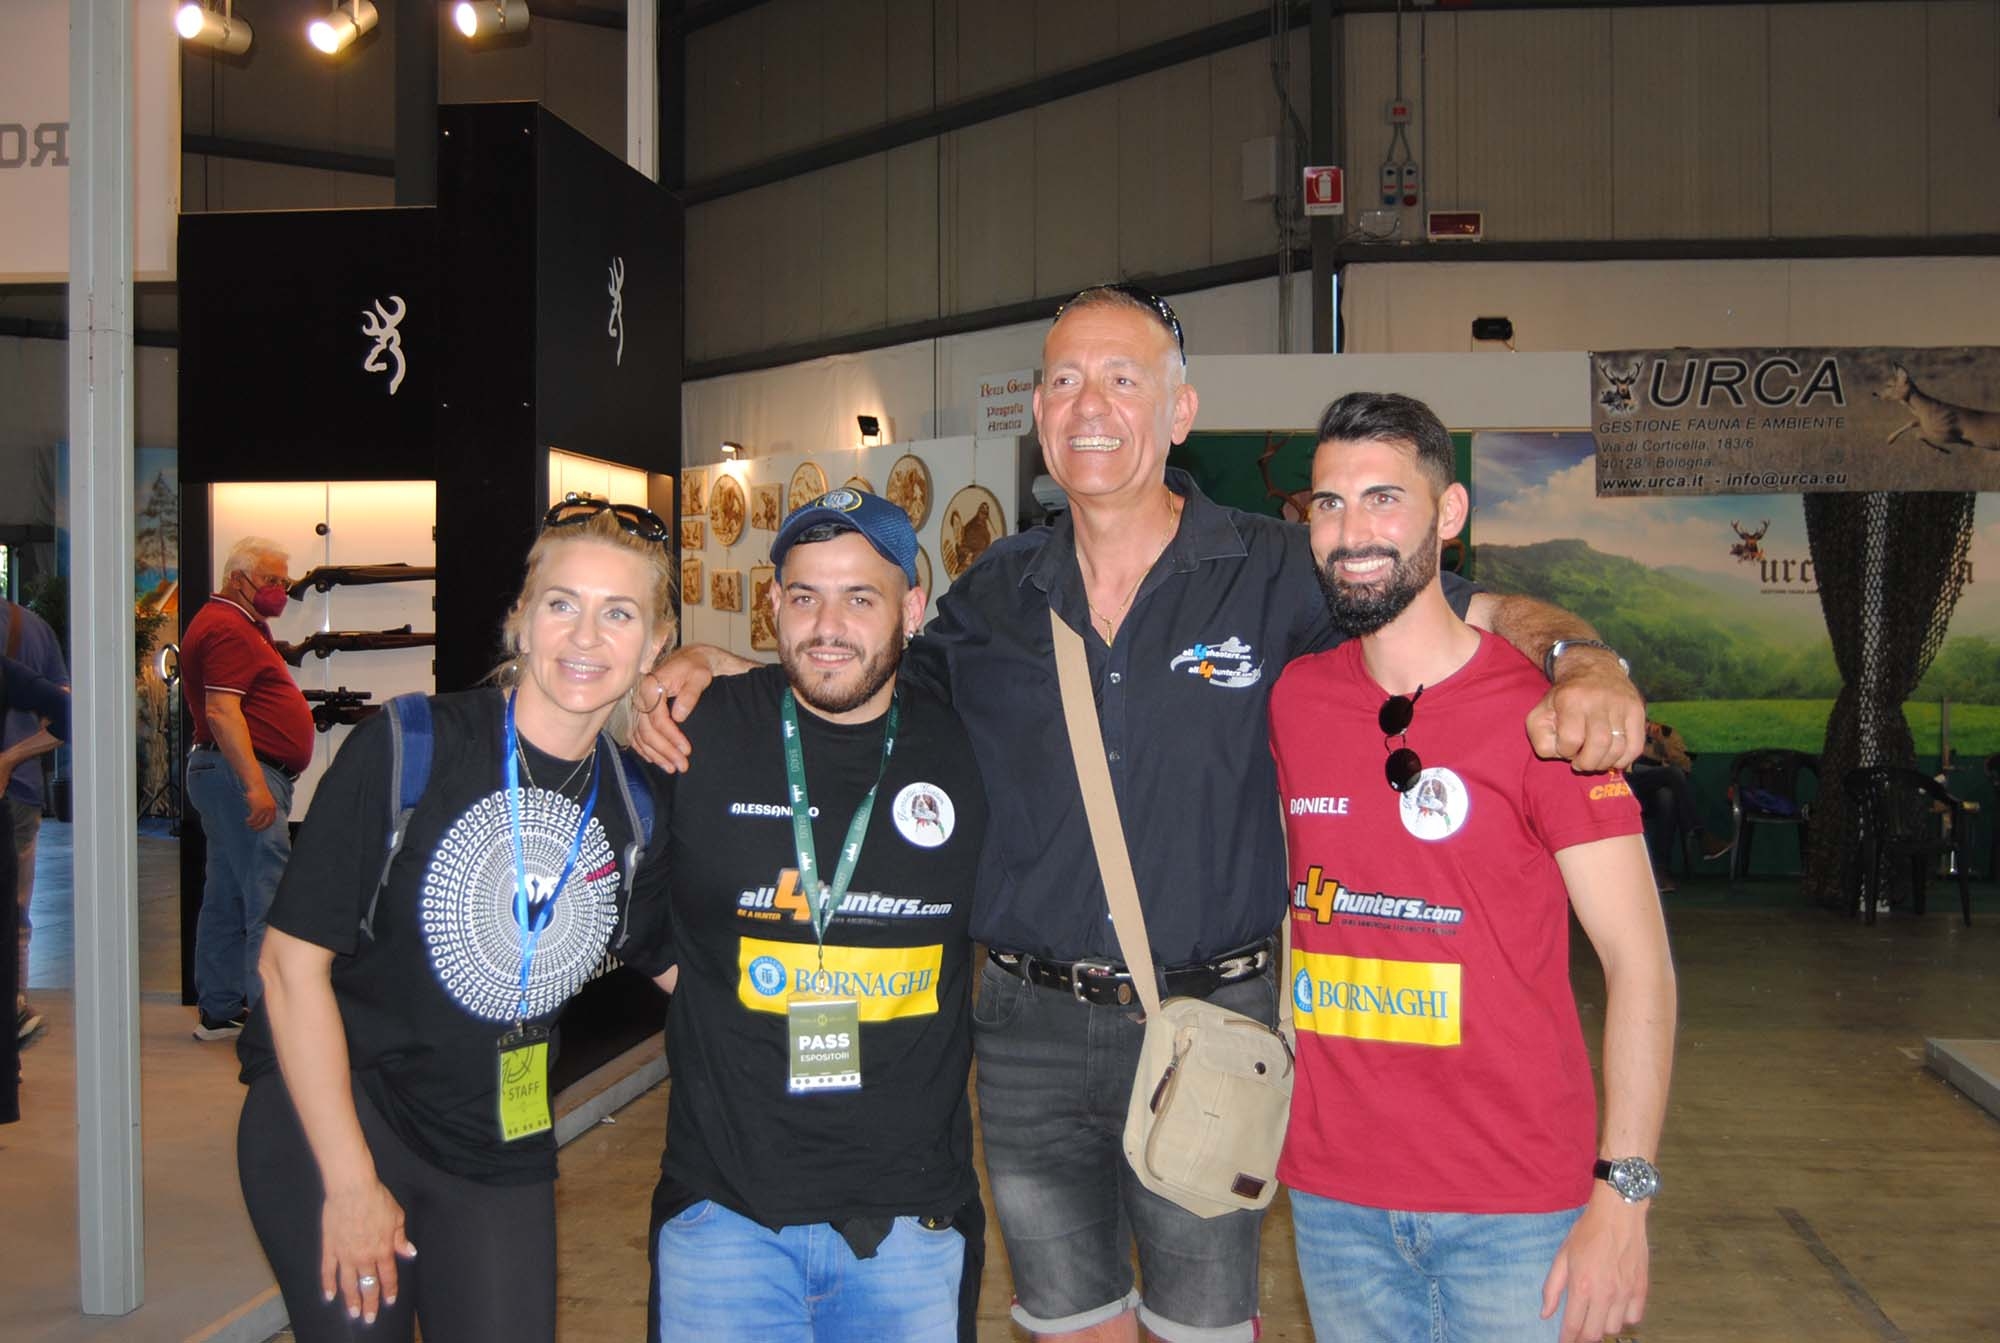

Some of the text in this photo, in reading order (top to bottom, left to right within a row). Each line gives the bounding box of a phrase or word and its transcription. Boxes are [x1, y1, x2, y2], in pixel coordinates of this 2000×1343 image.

[1648, 357, 1846, 408] URCA
[1600, 416, 1845, 434] GESTIONE FAUNA E AMBIENTE
[1625, 441, 1638, 452] di
[1717, 437, 1755, 449] 183/6
[1602, 474, 1704, 490] www.urca.it
[1726, 472, 1848, 488] info@urca.eu
[731, 802, 820, 817] ALESSANO
[1290, 797, 1349, 815] DANIELE
[585, 861, 617, 882] PINKO
[1294, 866, 1463, 925] ll4hunters.com
[794, 967, 933, 998] BORNAGHI
[1318, 980, 1449, 1018] BORNAGHI
[799, 1033, 850, 1050] PASS
[800, 1052, 850, 1062] ESPOSITORI
[508, 1081, 541, 1101] STAFF
